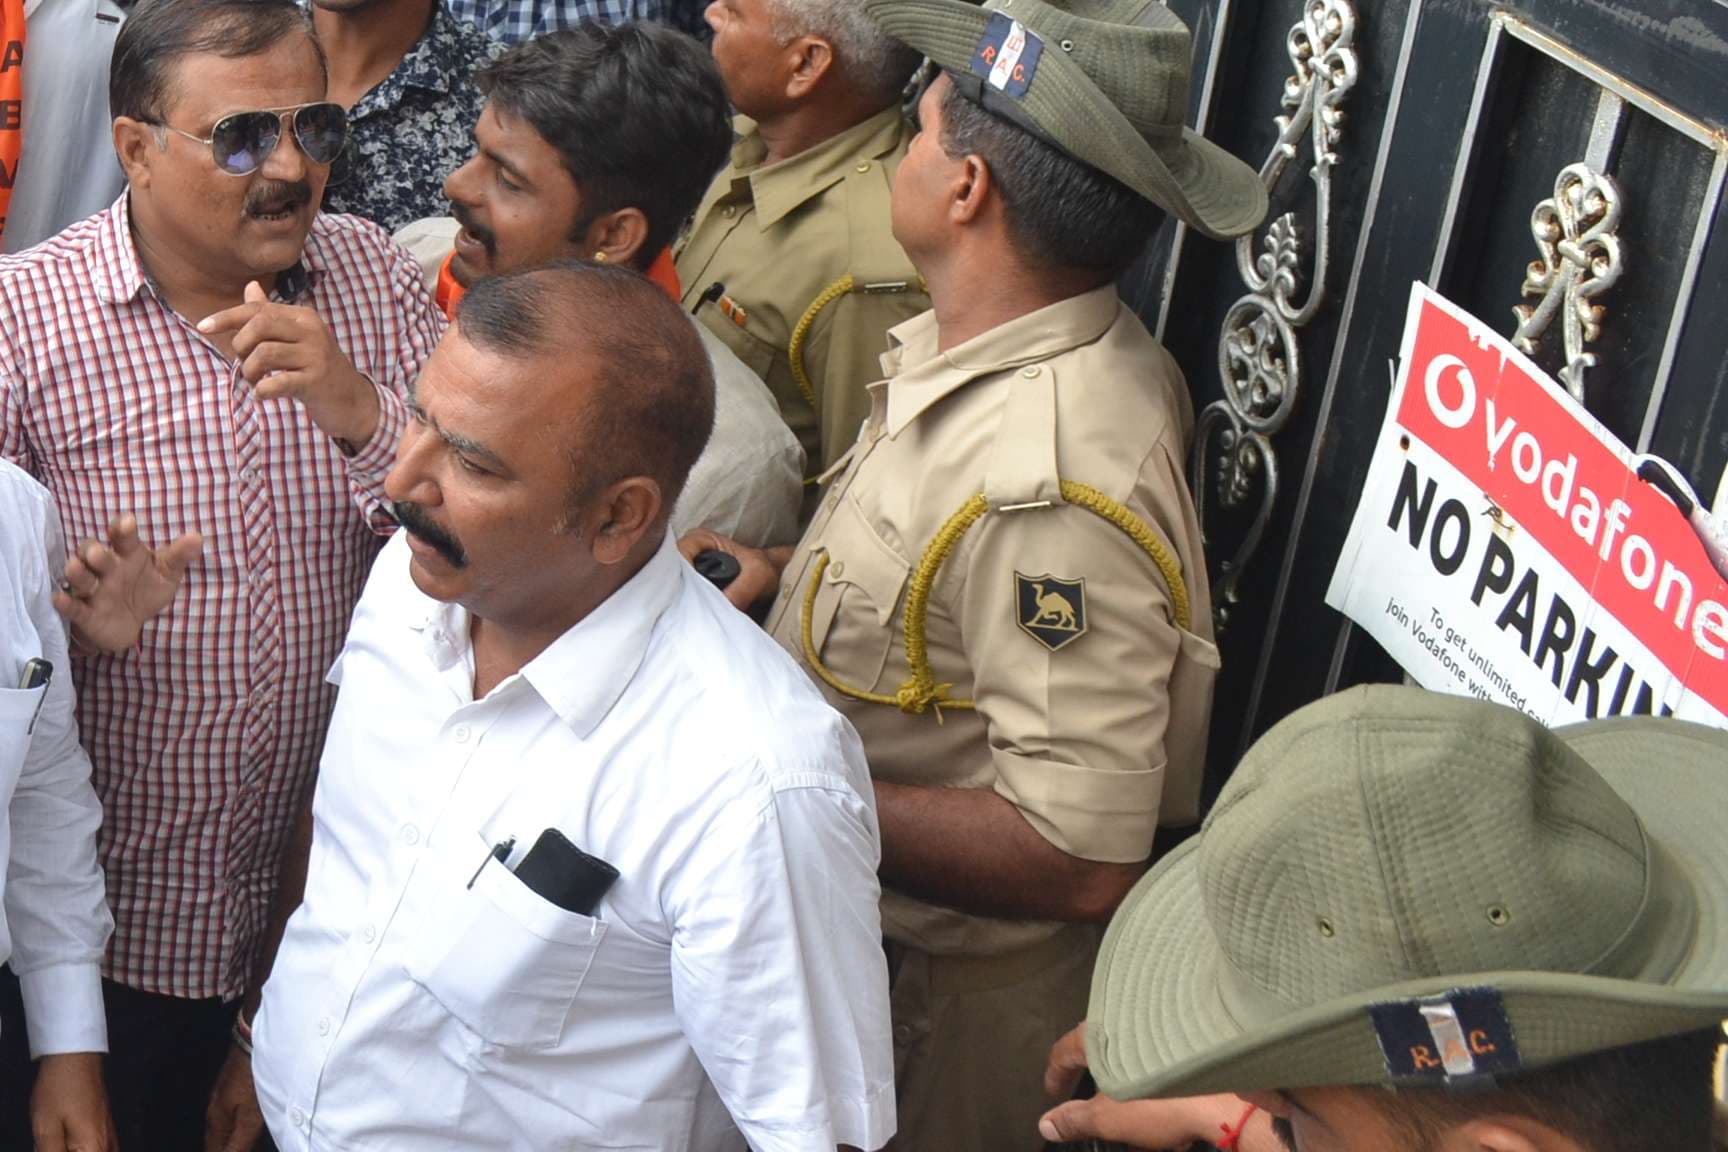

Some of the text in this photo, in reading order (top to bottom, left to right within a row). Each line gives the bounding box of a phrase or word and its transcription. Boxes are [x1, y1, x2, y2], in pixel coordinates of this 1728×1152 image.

[1387, 458, 1471, 576] NO
[1485, 398, 1728, 660] vodafone
[1385, 597, 1409, 628] join
[1411, 619, 1466, 682] Vodafone
[1431, 606, 1527, 711] To get unlimited
